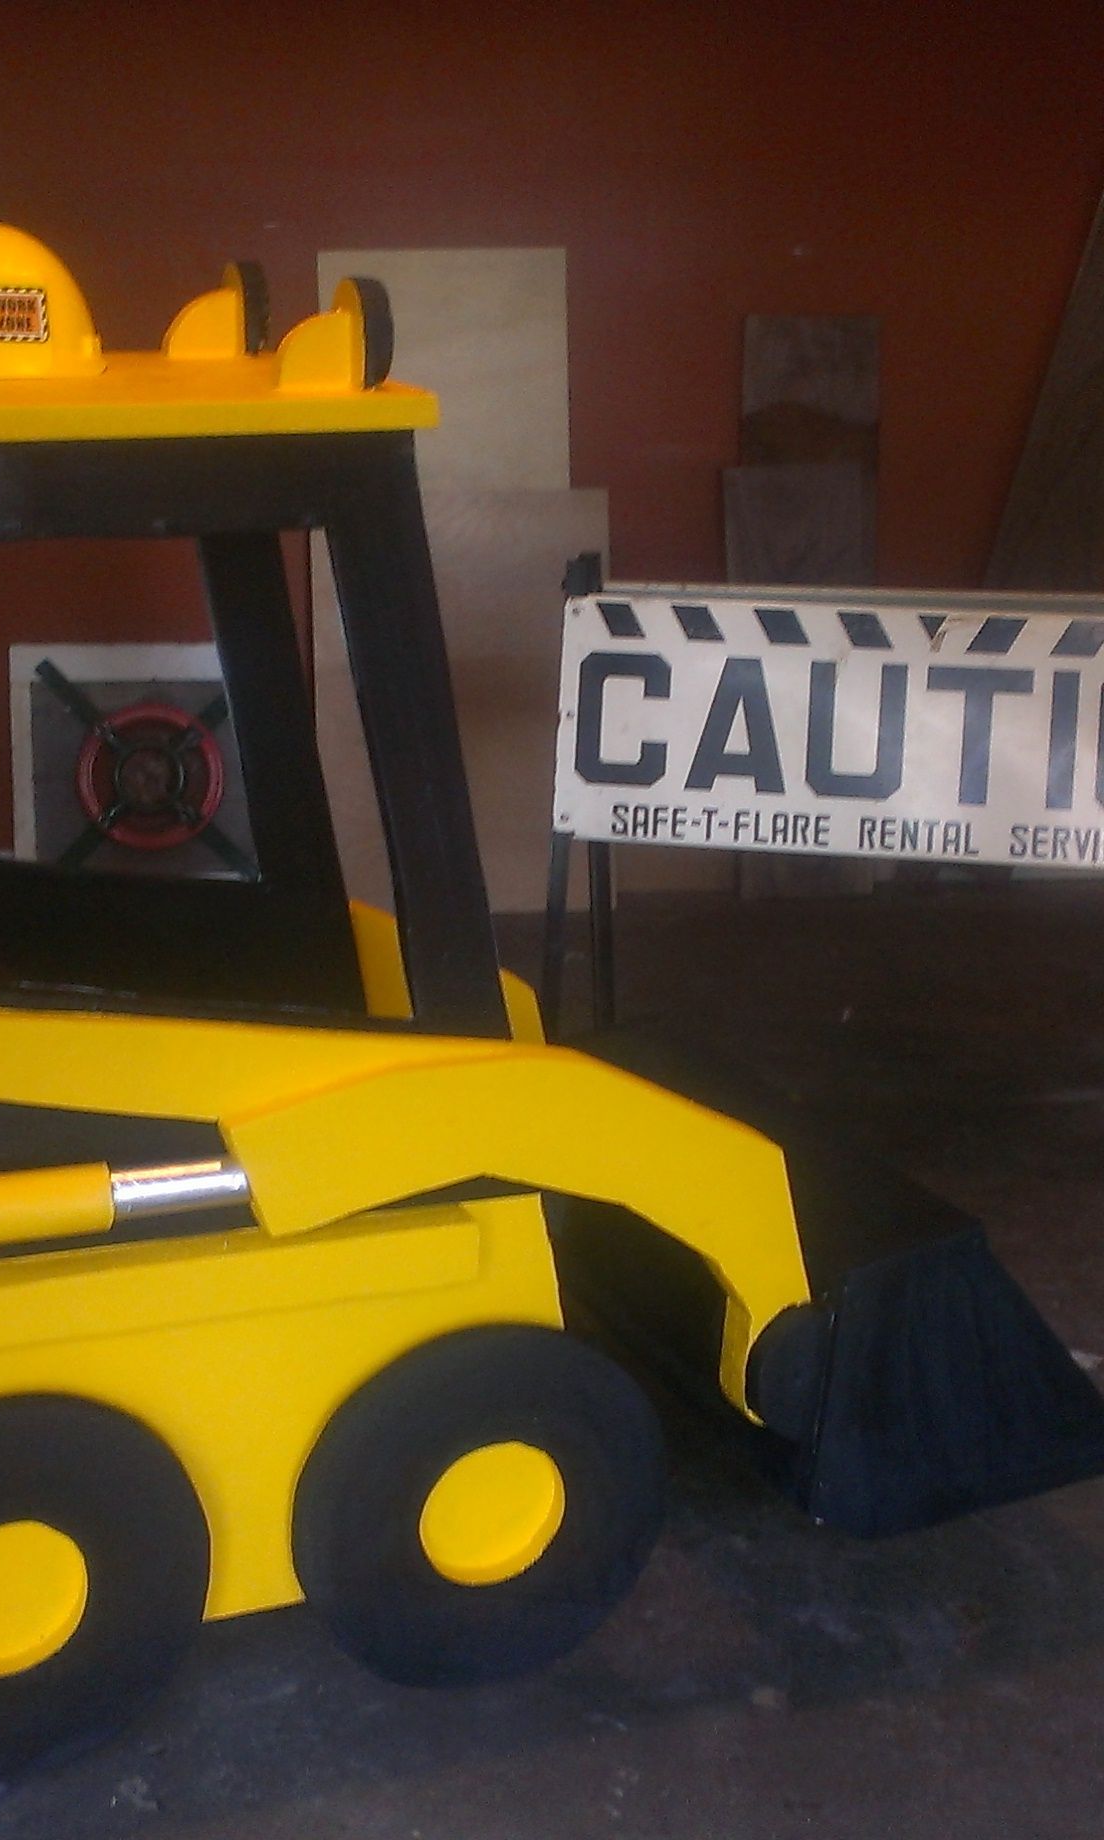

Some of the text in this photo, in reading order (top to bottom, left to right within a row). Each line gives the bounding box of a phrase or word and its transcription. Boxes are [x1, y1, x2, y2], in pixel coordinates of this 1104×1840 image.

[574, 651, 1104, 809] CAUTI
[611, 804, 1104, 863] SAFE-T-FLARE RENTAL SERVI
